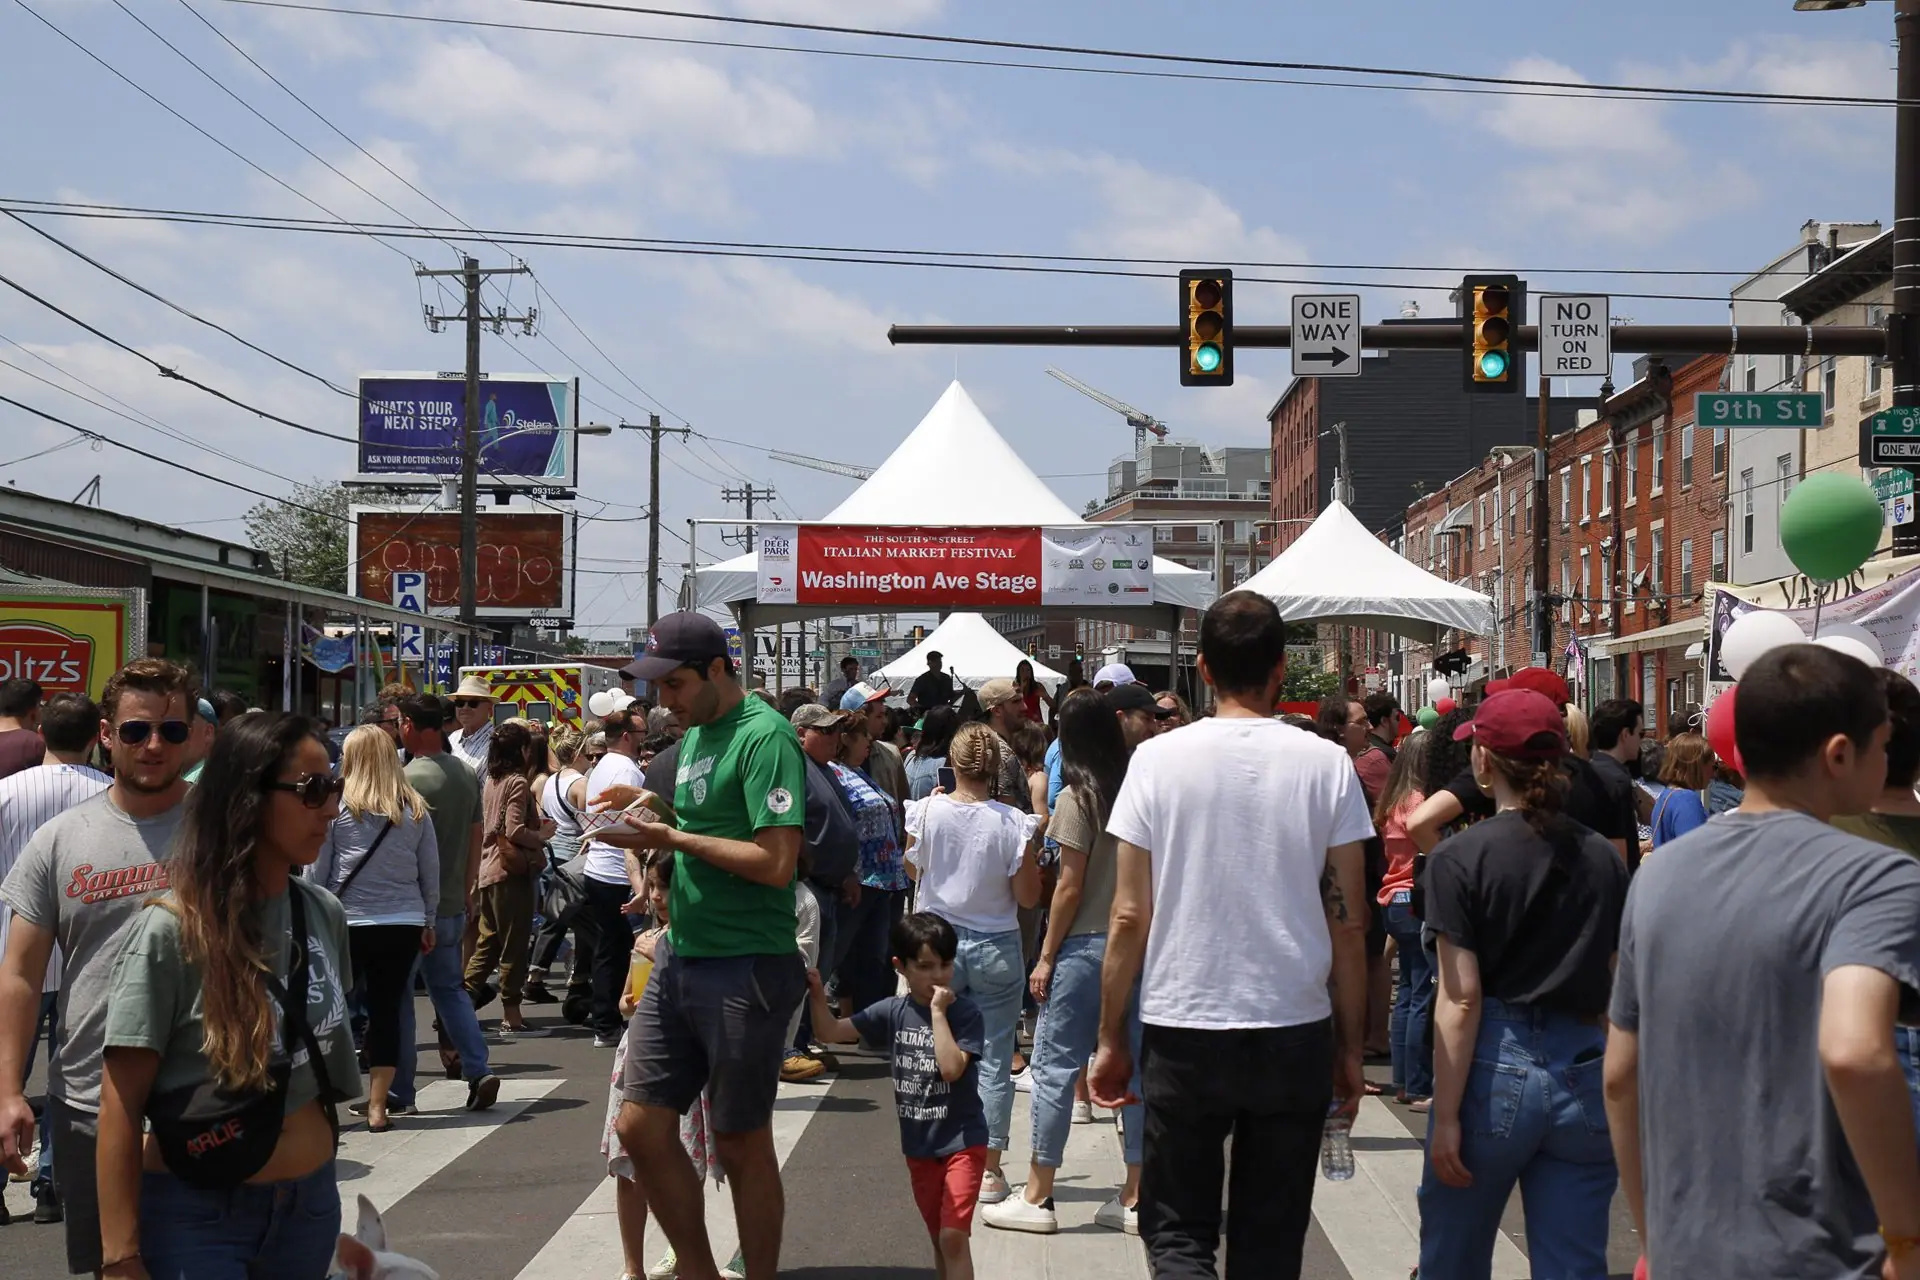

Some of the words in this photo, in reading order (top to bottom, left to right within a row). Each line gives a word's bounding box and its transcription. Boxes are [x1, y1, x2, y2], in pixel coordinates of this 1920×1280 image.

[1301, 302, 1351, 319] ONE
[1557, 302, 1591, 320] NO
[1301, 323, 1351, 341] WAY
[1550, 324, 1598, 337] TURN
[1562, 340, 1586, 353] ON
[1557, 356, 1592, 369] RED
[368, 400, 415, 415] WHAT'S
[419, 401, 453, 416] YOUR
[1713, 399, 1761, 420] 9th
[1776, 399, 1806, 420] St
[384, 416, 414, 430] NEXT
[419, 416, 458, 430] STEP?
[1881, 444, 1905, 455] ONE
[1908, 444, 1920, 455] WA
[367, 455, 382, 464] ASK
[382, 455, 402, 464] YOUR
[402, 455, 430, 464] DOCTOR
[1895, 506, 1904, 519] 95
[764, 539, 790, 548] DEER
[864, 535, 884, 543] THE
[886, 535, 921, 544] SOUTH
[938, 536, 975, 544] STREET
[764, 547, 790, 556] PARK
[823, 546, 882, 558] ITALIAN
[886, 547, 947, 558] MARKET
[950, 547, 1016, 559] FESTIVAL
[801, 570, 926, 593] Washington
[931, 571, 970, 590] Ave
[975, 571, 1037, 594] Stage
[530, 618, 560, 627] 093325
[93, 890, 112, 900] TAP
[116, 888, 123, 896] &
[895, 1030, 924, 1047] SULTAN
[914, 1049, 926, 1058] The
[895, 1054, 913, 1069] KING
